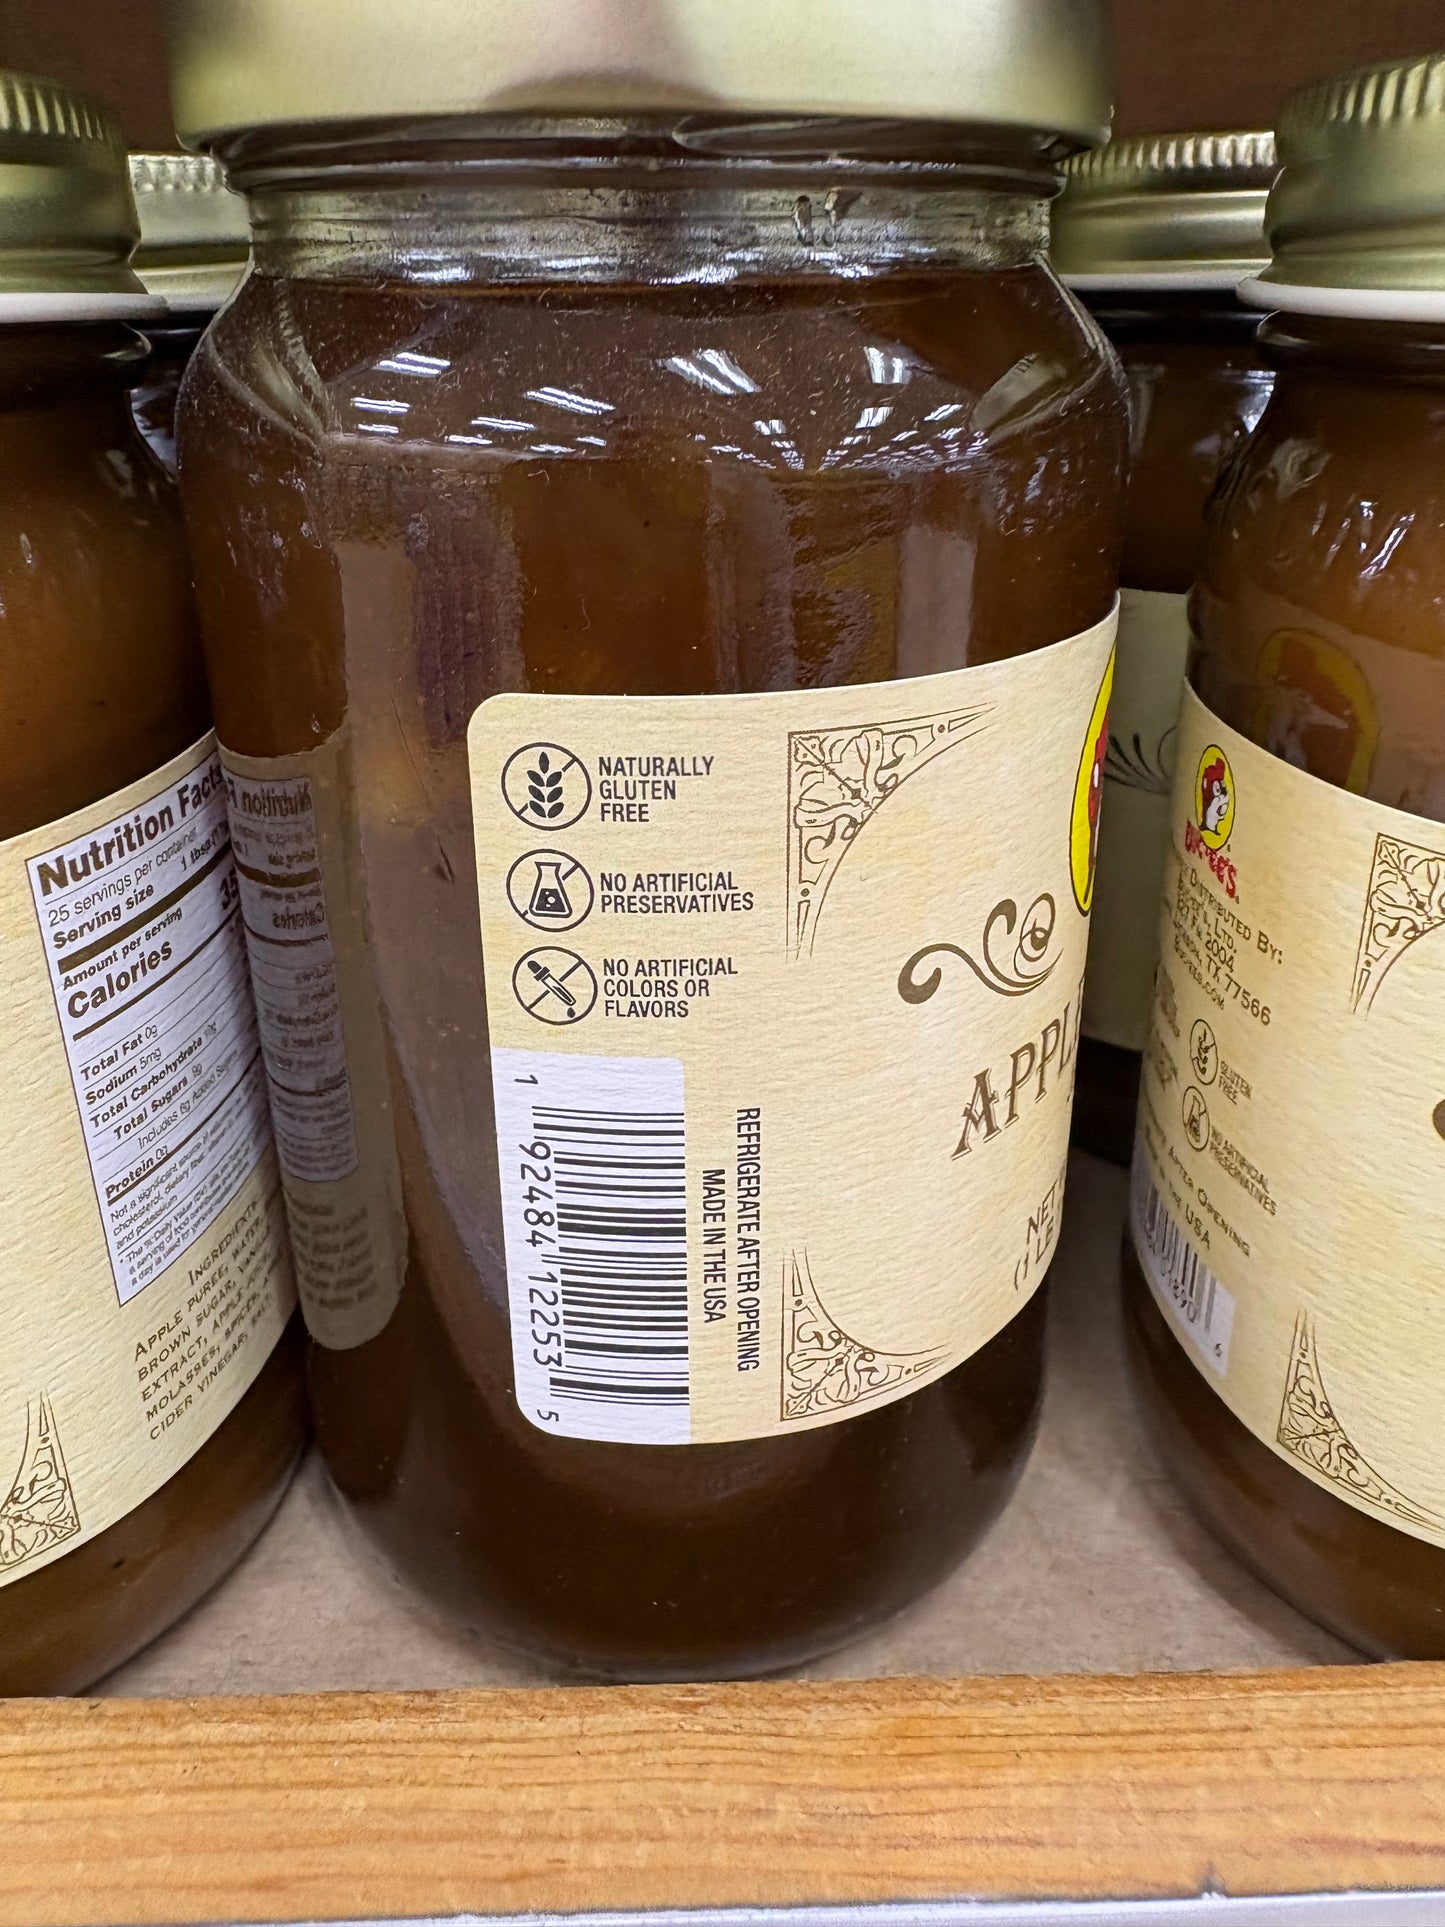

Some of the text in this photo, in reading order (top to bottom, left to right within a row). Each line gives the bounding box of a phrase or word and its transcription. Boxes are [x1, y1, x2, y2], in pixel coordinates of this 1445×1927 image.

[599, 756, 714, 777] NATURALLY
[600, 780, 676, 800] GLUTEN
[600, 803, 650, 823] FREE
[37, 805, 174, 896] Nutrition
[49, 904, 70, 927] 25
[75, 874, 131, 915] servings
[135, 859, 152, 885] per
[600, 871, 738, 892] NO ARTIFICIAL
[601, 892, 754, 913] PRESERVATIVES
[54, 904, 121, 949] Serving
[126, 884, 154, 911] size
[64, 907, 183, 991] Amount per serving
[603, 957, 738, 976] NO ARTIFICIAL
[67, 941, 173, 1019] Calories
[603, 979, 710, 997] COLORS OR
[1223, 971, 1271, 1025] 77566
[605, 1001, 689, 1018] FLAVORS
[80, 1024, 158, 1081] Total Fat 0g
[85, 1047, 162, 1105] Sodium 5mg
[515, 1074, 538, 1085] 1
[90, 1099, 128, 1128] Total
[131, 1036, 203, 1101] Carbohydrate
[113, 1108, 147, 1141] Total
[151, 1076, 188, 1113] Sugars
[138, 1112, 178, 1149] Includes
[105, 1157, 154, 1199] Protein
[519, 1141, 556, 1247] 92484
[110, 1204, 128, 1223] Not
[736, 1107, 761, 1372] REFRIGERATE AFTER OPENING
[703, 1169, 727, 1324] MADE IN THE USA
[135, 1310, 183, 1362] APPLE
[528, 1273, 562, 1367] 12253
[137, 1327, 191, 1383] BROWN
[142, 1335, 208, 1402] EXTRACT,
[150, 1394, 193, 1440] CIDER
[537, 1409, 559, 1422] 5
